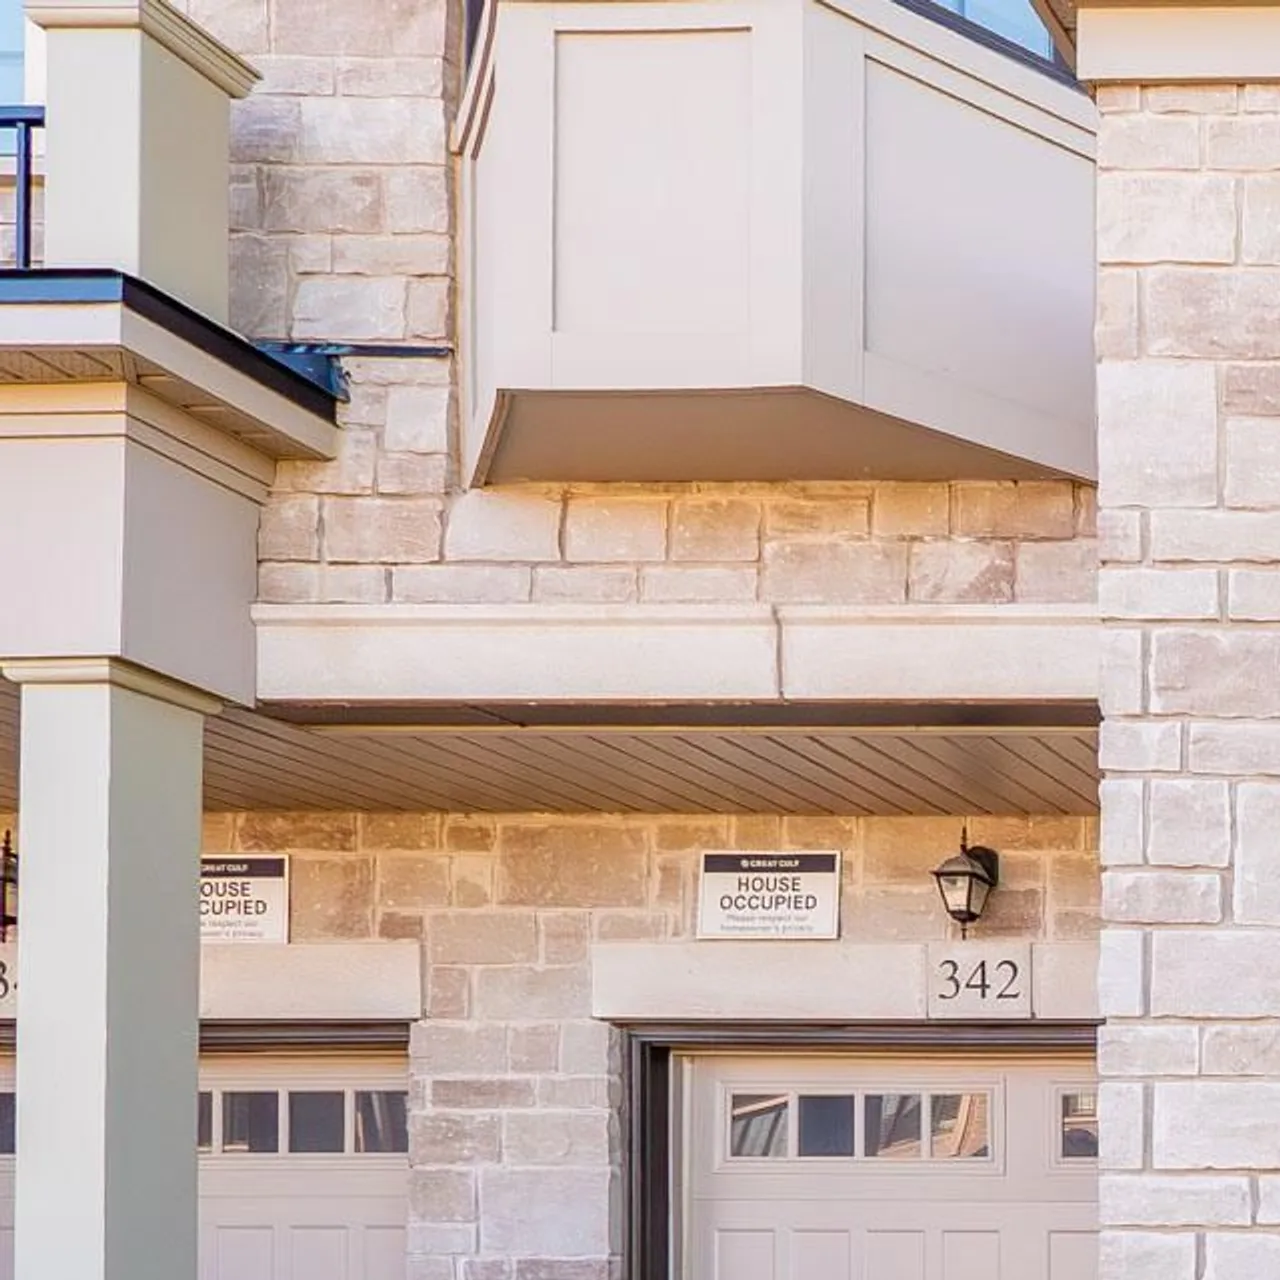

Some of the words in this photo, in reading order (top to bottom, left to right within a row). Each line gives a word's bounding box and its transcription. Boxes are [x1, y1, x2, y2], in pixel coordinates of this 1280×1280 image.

[750, 859, 778, 868] GREAT
[779, 859, 800, 868] GULF
[200, 881, 251, 897] OUSE
[737, 876, 802, 892] HOUSE
[200, 900, 267, 915] CUPIED
[719, 894, 817, 911] OCCUPIED
[938, 960, 1020, 999] 342
